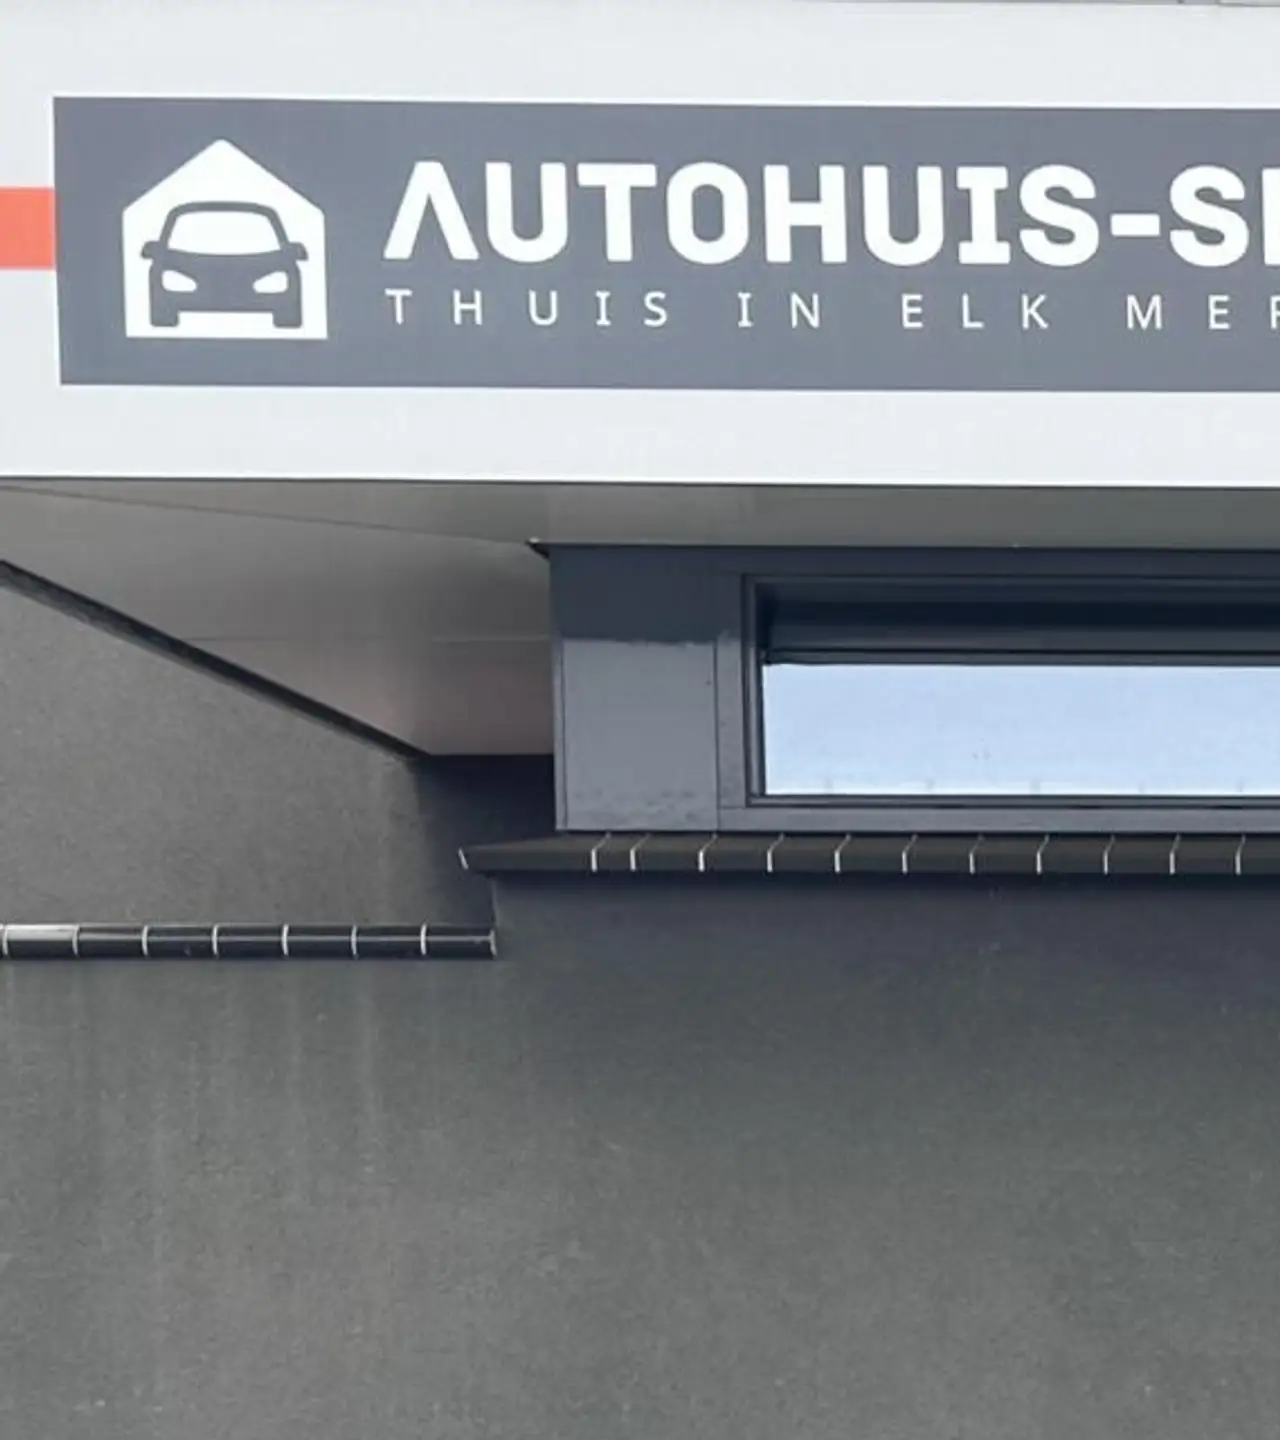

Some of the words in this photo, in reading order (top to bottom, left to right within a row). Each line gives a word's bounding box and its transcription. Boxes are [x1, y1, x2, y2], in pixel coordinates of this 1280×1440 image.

[384, 288, 668, 327] THUIS
[737, 291, 820, 329] IN
[901, 293, 1049, 329] ELK
